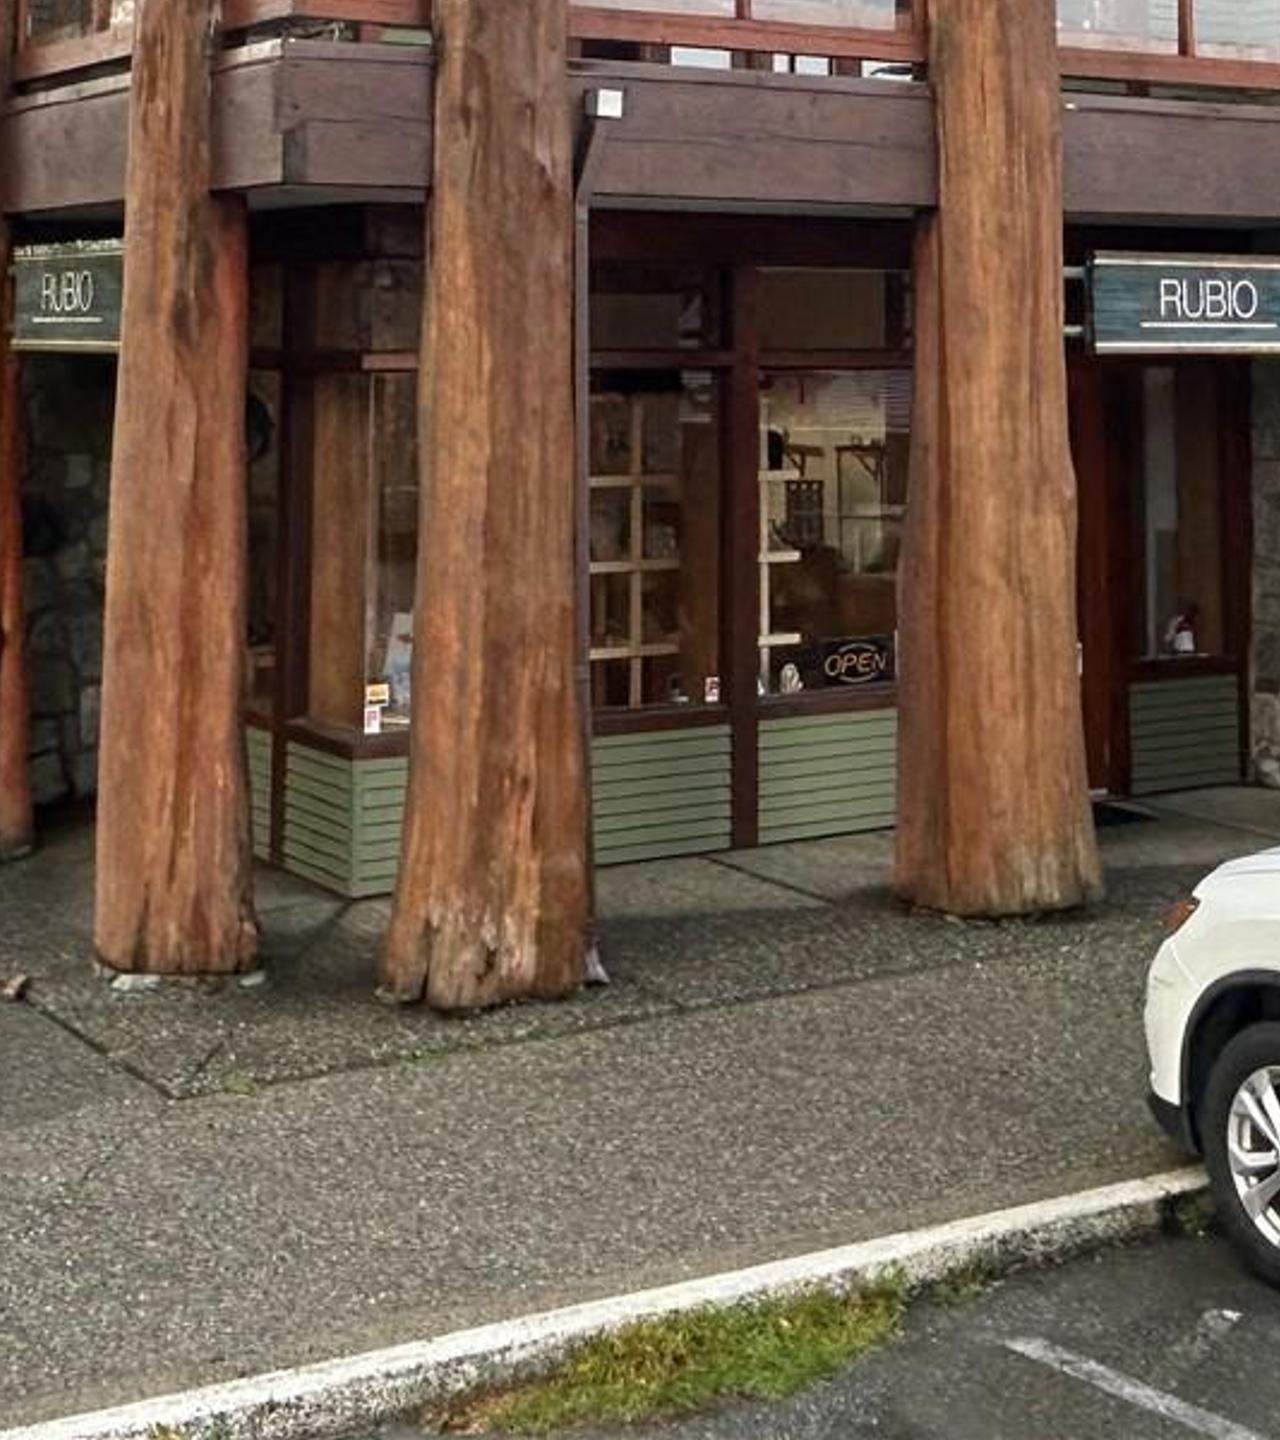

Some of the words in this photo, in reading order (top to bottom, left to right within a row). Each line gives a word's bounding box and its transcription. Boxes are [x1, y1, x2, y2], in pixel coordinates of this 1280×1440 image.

[41, 270, 94, 312] RUBIO
[1159, 278, 1258, 319] RUBIO
[824, 651, 887, 677] OPEN
